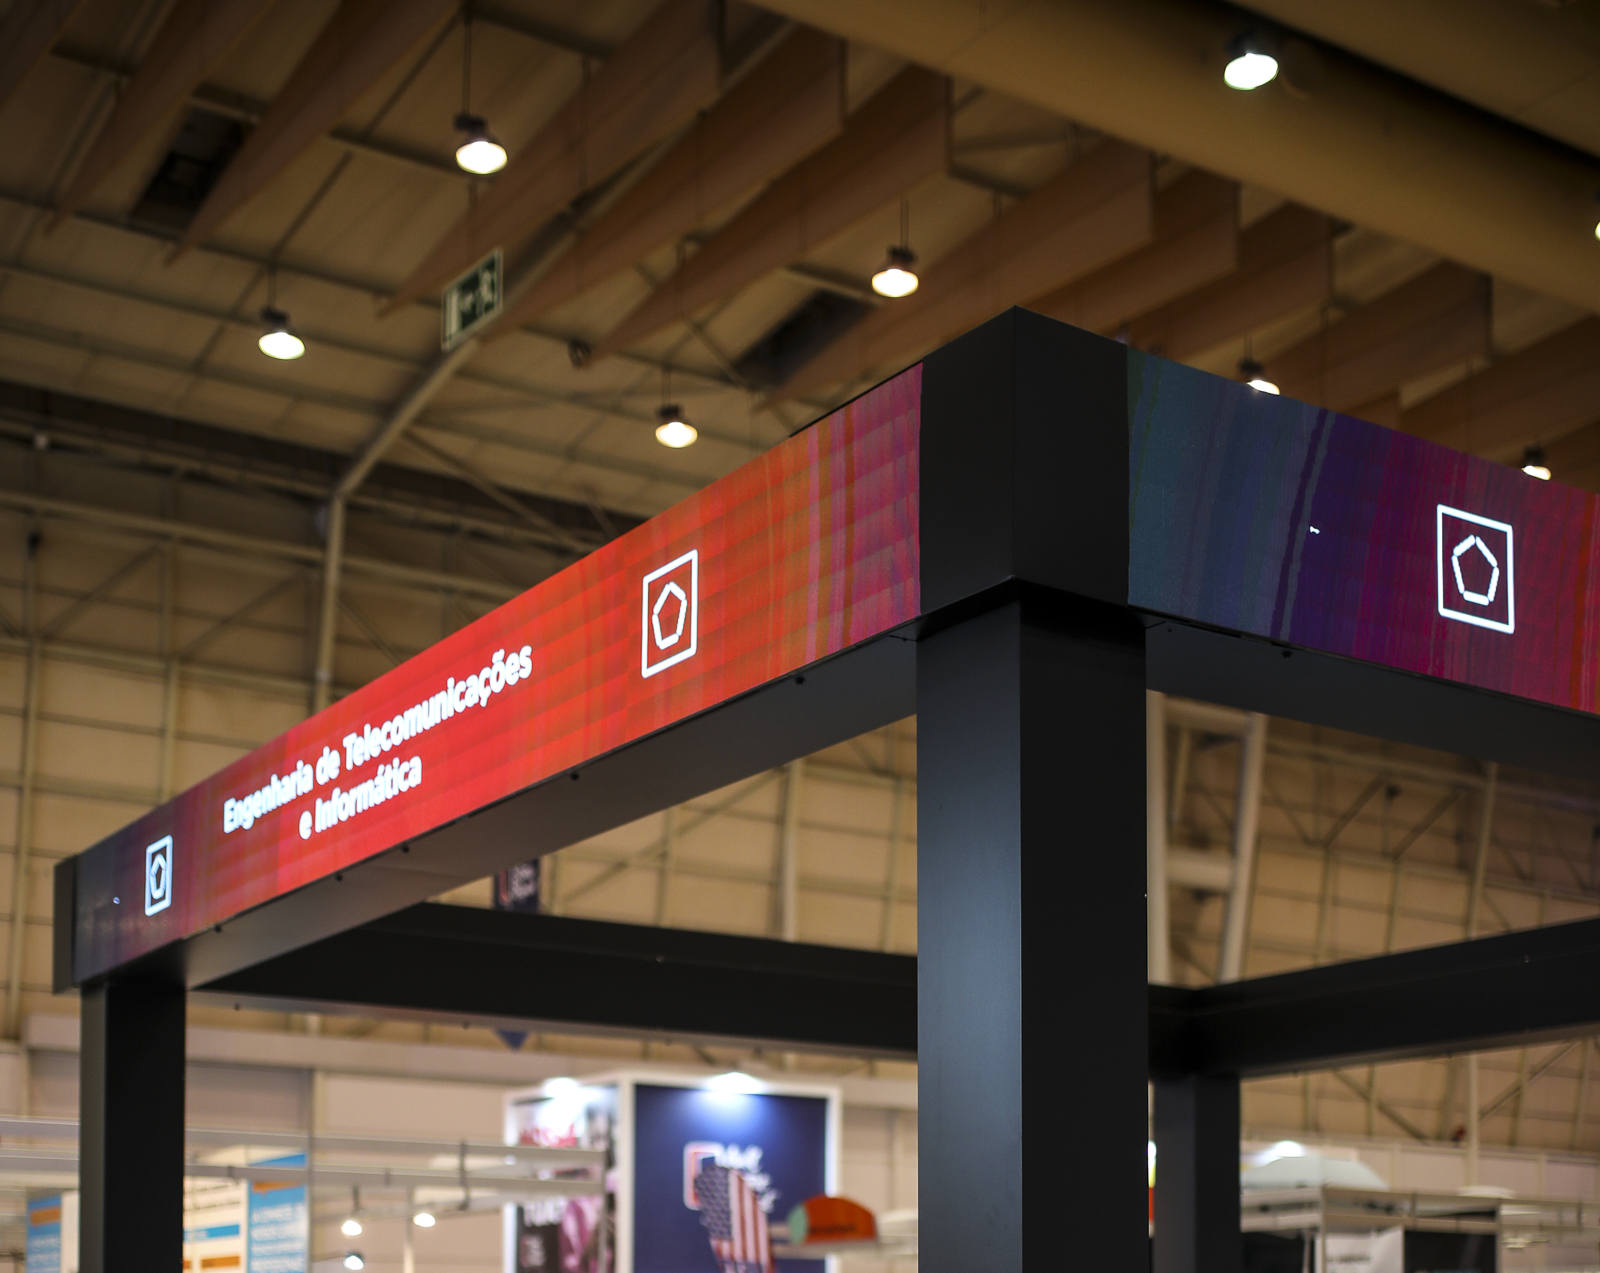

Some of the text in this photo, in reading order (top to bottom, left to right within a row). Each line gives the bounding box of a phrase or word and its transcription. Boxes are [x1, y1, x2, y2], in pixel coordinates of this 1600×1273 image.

[223, 645, 532, 834] Engenharia de Telecomunicações
[299, 755, 423, 839] e Informática
